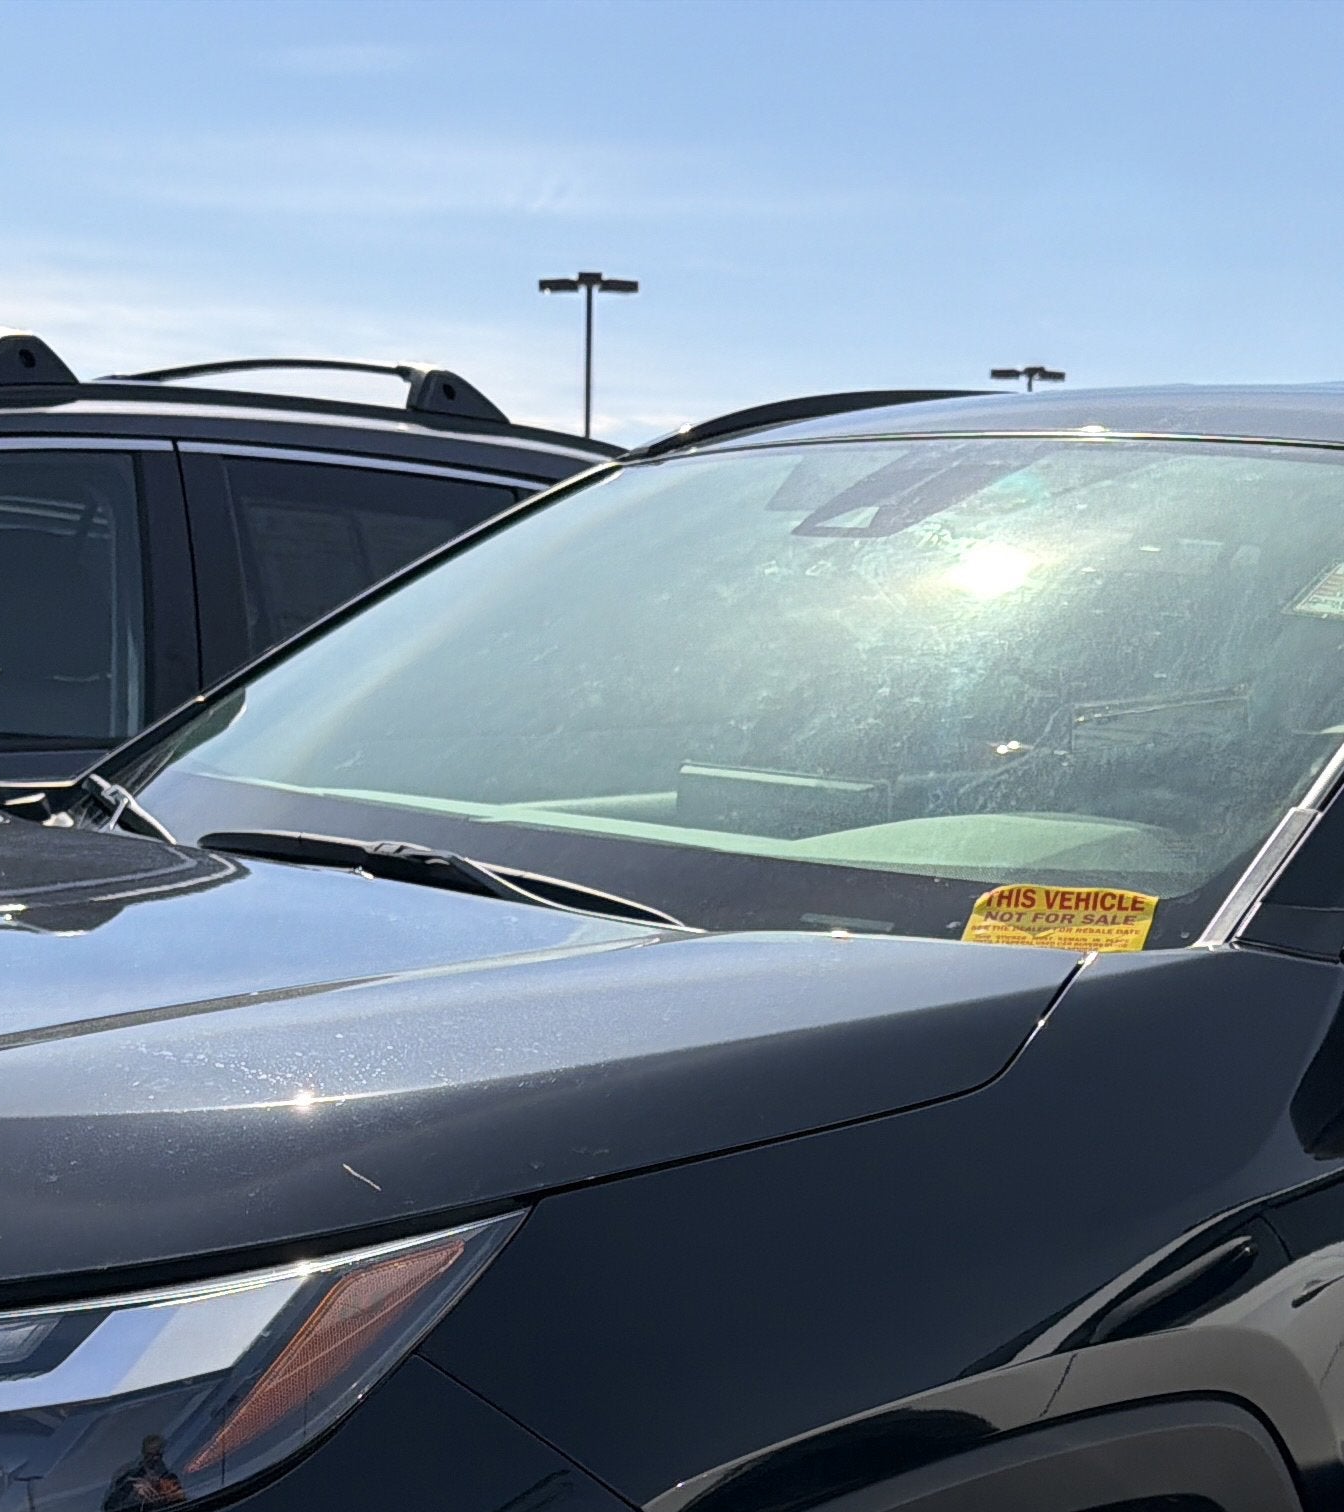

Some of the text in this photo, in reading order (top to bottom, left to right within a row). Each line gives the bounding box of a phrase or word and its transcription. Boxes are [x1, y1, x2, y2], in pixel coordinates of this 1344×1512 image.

[986, 888, 1145, 912] THIS VEHICLE
[984, 911, 1137, 926] NOT FOR SALE
